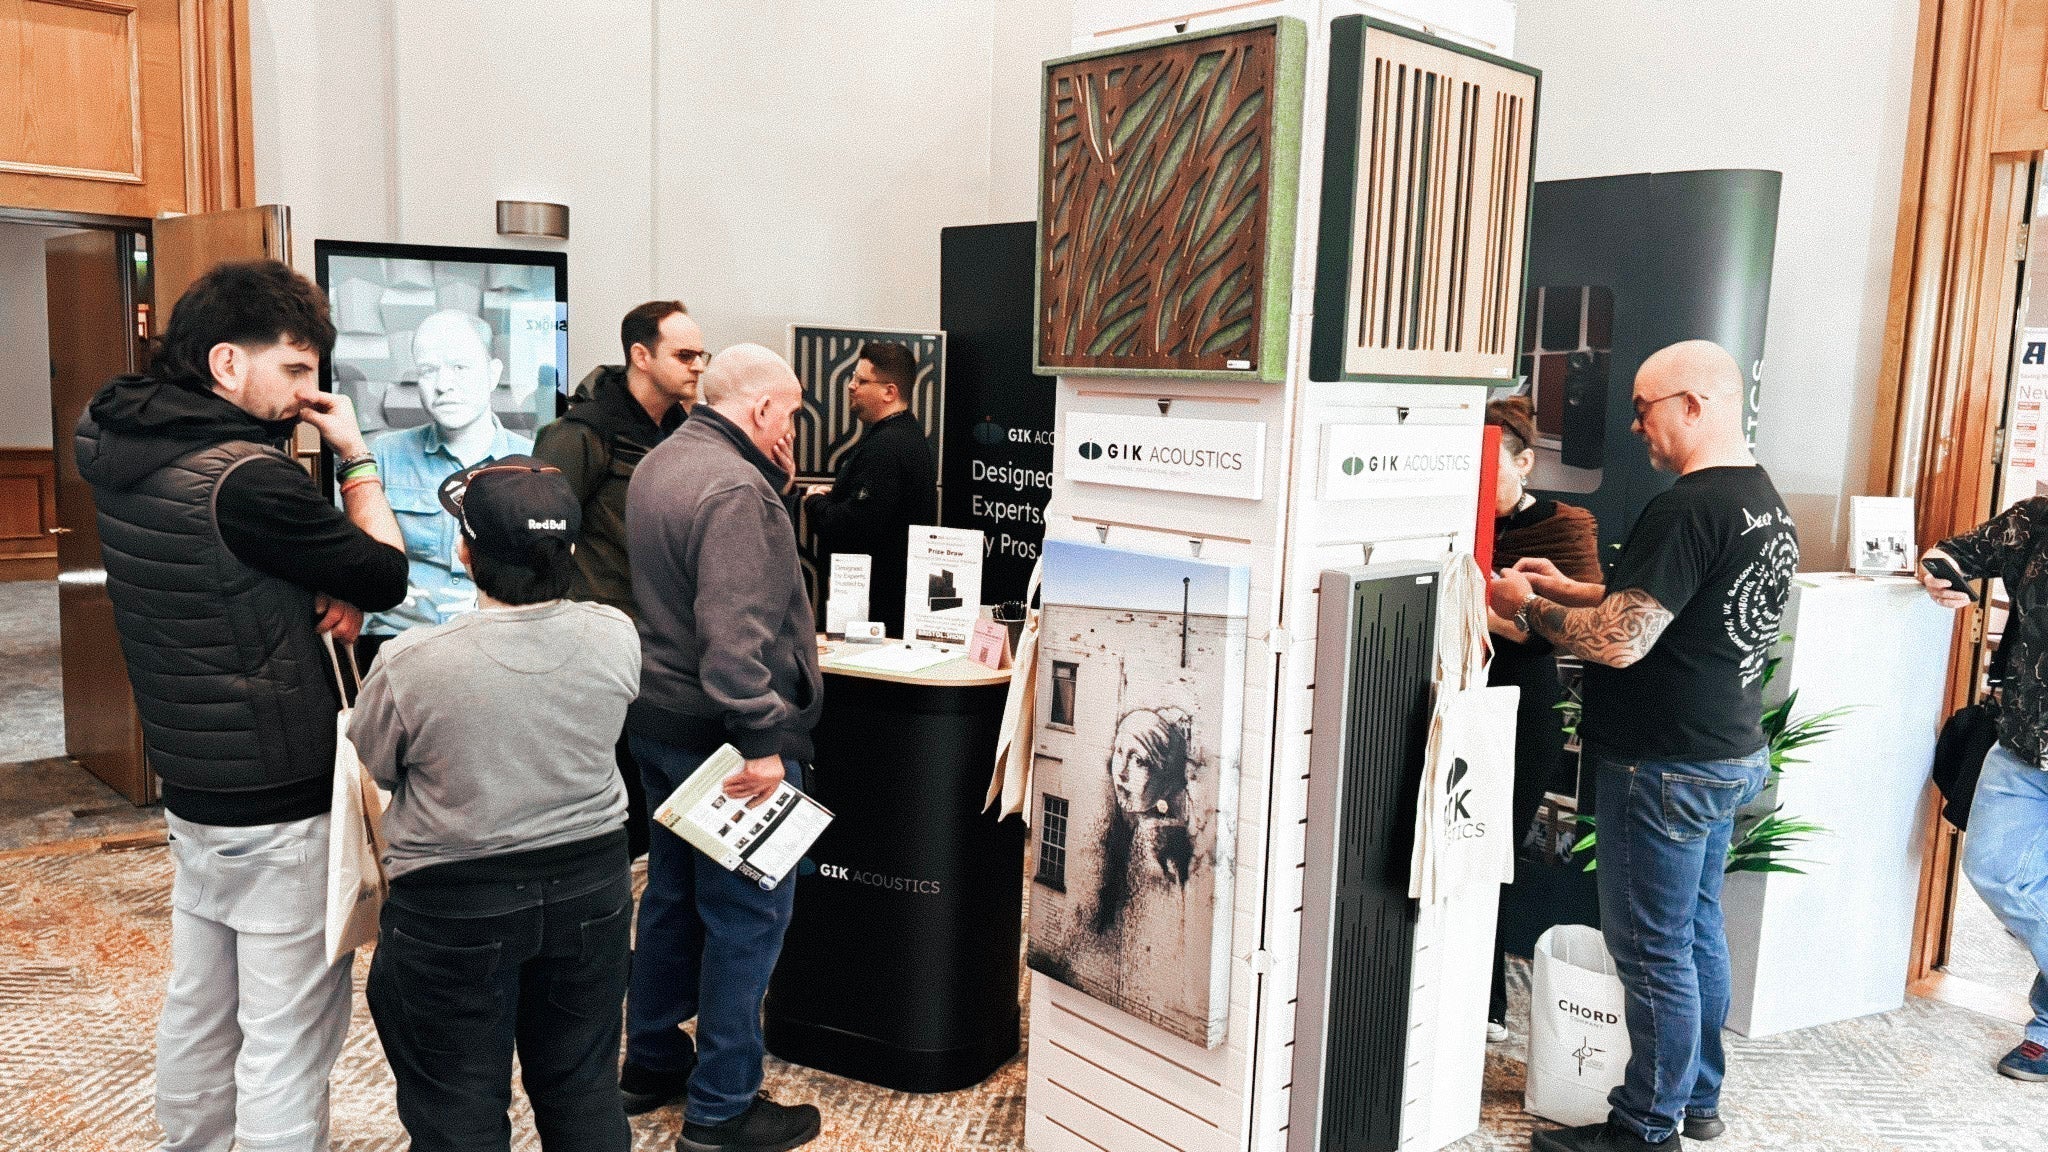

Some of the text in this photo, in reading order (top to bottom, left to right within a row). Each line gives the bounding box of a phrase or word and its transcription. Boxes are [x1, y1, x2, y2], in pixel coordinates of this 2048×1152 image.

[1008, 428, 1032, 443] GIK
[1107, 443, 1143, 461] GIK
[1149, 446, 1243, 471] ACOUSTICS
[1369, 454, 1471, 472] GIK ACOUSTICS
[972, 494, 1044, 525] Experts.
[528, 518, 567, 531] Red Bull
[927, 547, 964, 557] Prize Draw
[820, 863, 941, 894] GIK ACOUSTICS
[1558, 999, 1618, 1025] CHORD
